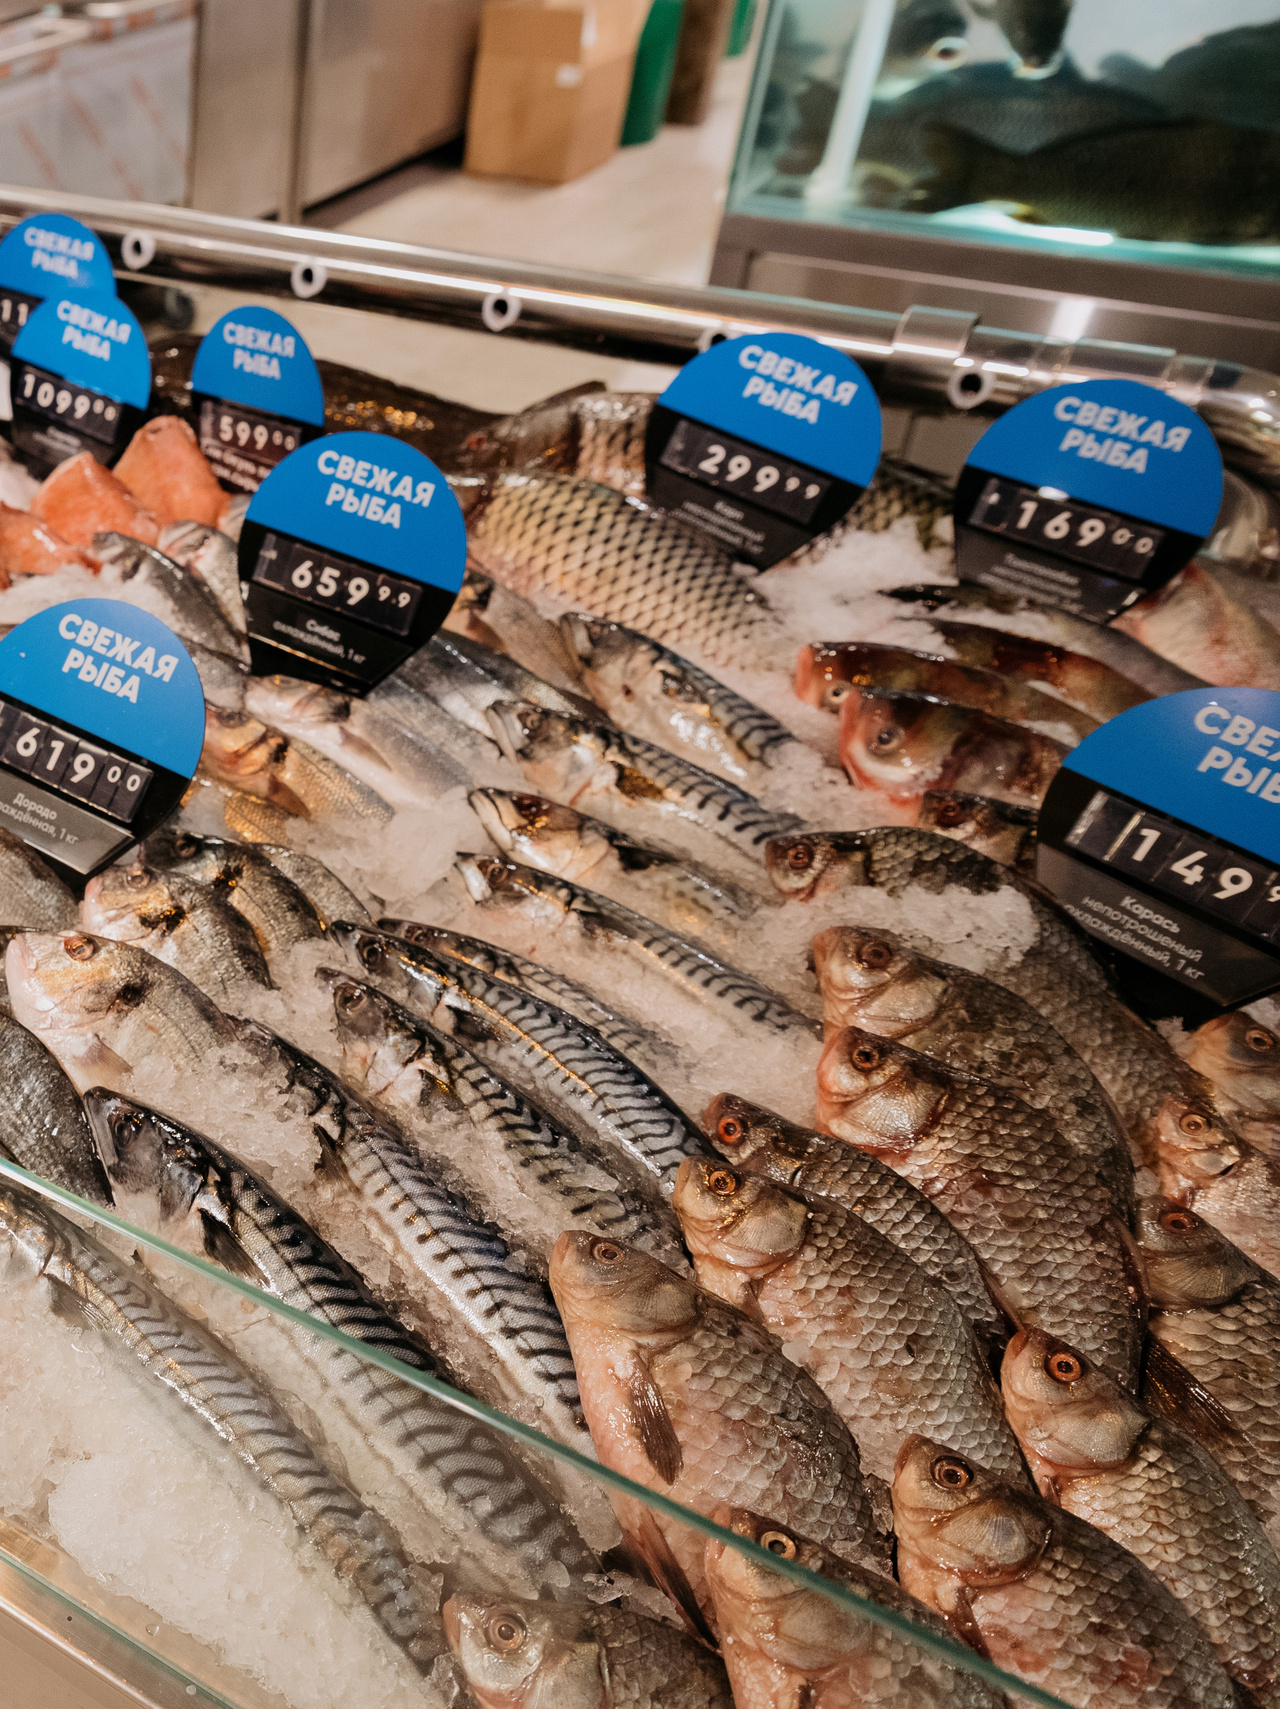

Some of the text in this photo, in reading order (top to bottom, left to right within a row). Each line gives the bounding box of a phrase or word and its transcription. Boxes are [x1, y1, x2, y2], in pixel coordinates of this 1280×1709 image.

[23, 226, 95, 262] СВЕЖАЯ
[31, 249, 80, 280] РЫБА
[56, 300, 132, 344] СВЕЖАЯ
[62, 326, 112, 362] РЫБА
[222, 321, 296, 358] СВЕЖАЯ
[233, 348, 282, 380] РЫБА
[738, 345, 860, 406] СВЕЖАЯ
[742, 376, 822, 425] РЫБА
[1053, 396, 1192, 453] СВЕЖАЯ
[1059, 428, 1149, 474] РЫБА
[316, 449, 436, 508] СВЕЖАЯ
[325, 482, 403, 530] РЫБА
[58, 613, 180, 683] СВЕЖАЯ
[61, 648, 141, 704] РЫБА
[12, 791, 58, 821] Дорадо
[1081, 895, 1204, 963] непотрошеный
[1119, 894, 1181, 935] Карась
[1183, 965, 1206, 981] кг
